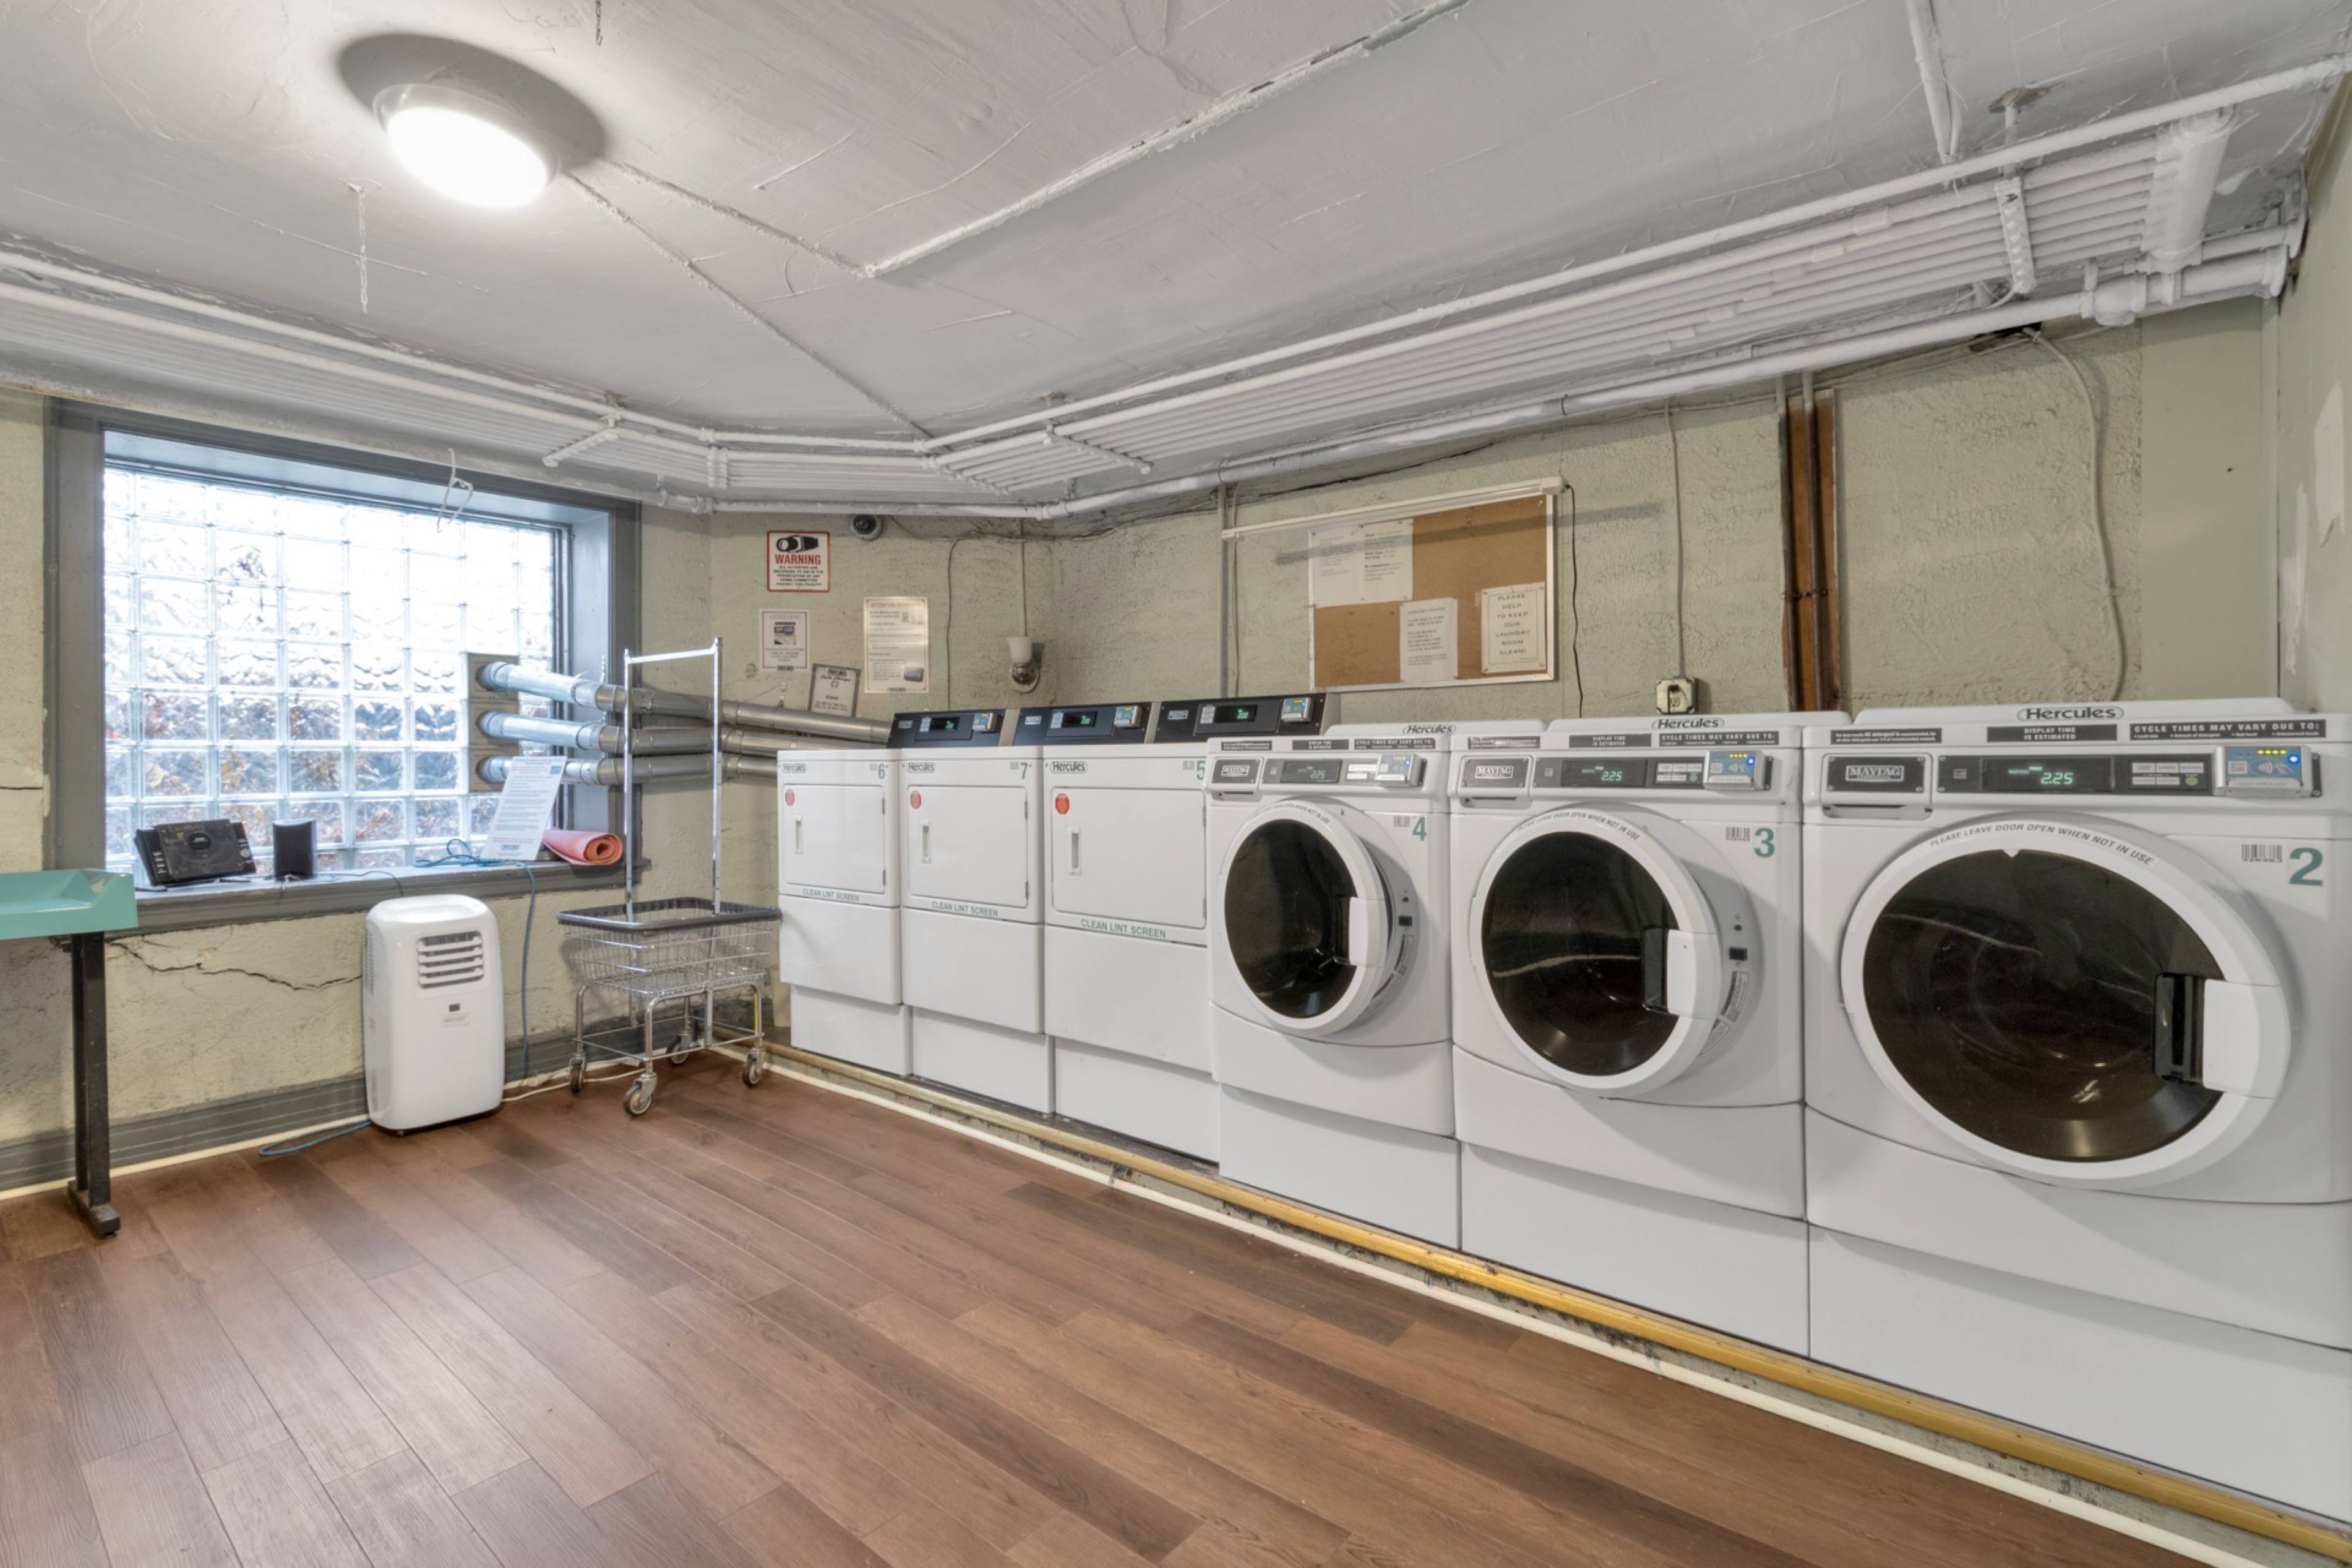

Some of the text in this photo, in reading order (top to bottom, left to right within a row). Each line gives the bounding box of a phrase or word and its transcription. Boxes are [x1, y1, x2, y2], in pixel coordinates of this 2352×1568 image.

[775, 554, 821, 565] WARNING
[2026, 707, 2116, 720] Hercules
[1407, 725, 1452, 734] Hercules
[1657, 718, 1719, 729] Hercules
[878, 764, 886, 779] 6
[908, 762, 934, 771] Hercules
[1020, 763, 1028, 779] 7
[1053, 762, 1085, 772] Hercules
[1196, 761, 1206, 780] 5
[1476, 766, 1511, 774] MAYTAG
[1849, 767, 1901, 775] MAYTAG
[2041, 772, 2073, 785] 2.25
[1412, 816, 1427, 841] 4
[1587, 814, 1607, 823] WHEN
[1606, 819, 1621, 828] NOT
[1626, 829, 1641, 840] USE
[1754, 827, 1774, 858] 3
[1931, 831, 1961, 848] PLEASE
[1964, 825, 1992, 836] LEAVE
[2027, 824, 2056, 832] OPEN
[2058, 827, 2090, 840] WHEN
[2092, 835, 2117, 848] NOT
[2116, 844, 2130, 854] IN
[2130, 850, 2154, 865] USE
[2289, 847, 2323, 886] 2
[804, 888, 821, 896] CLEAN
[836, 892, 859, 902] SCREEN
[932, 901, 998, 917] CLEAN LINT SCREEN
[1081, 918, 1166, 938] CLEAN LINT SCREEN
